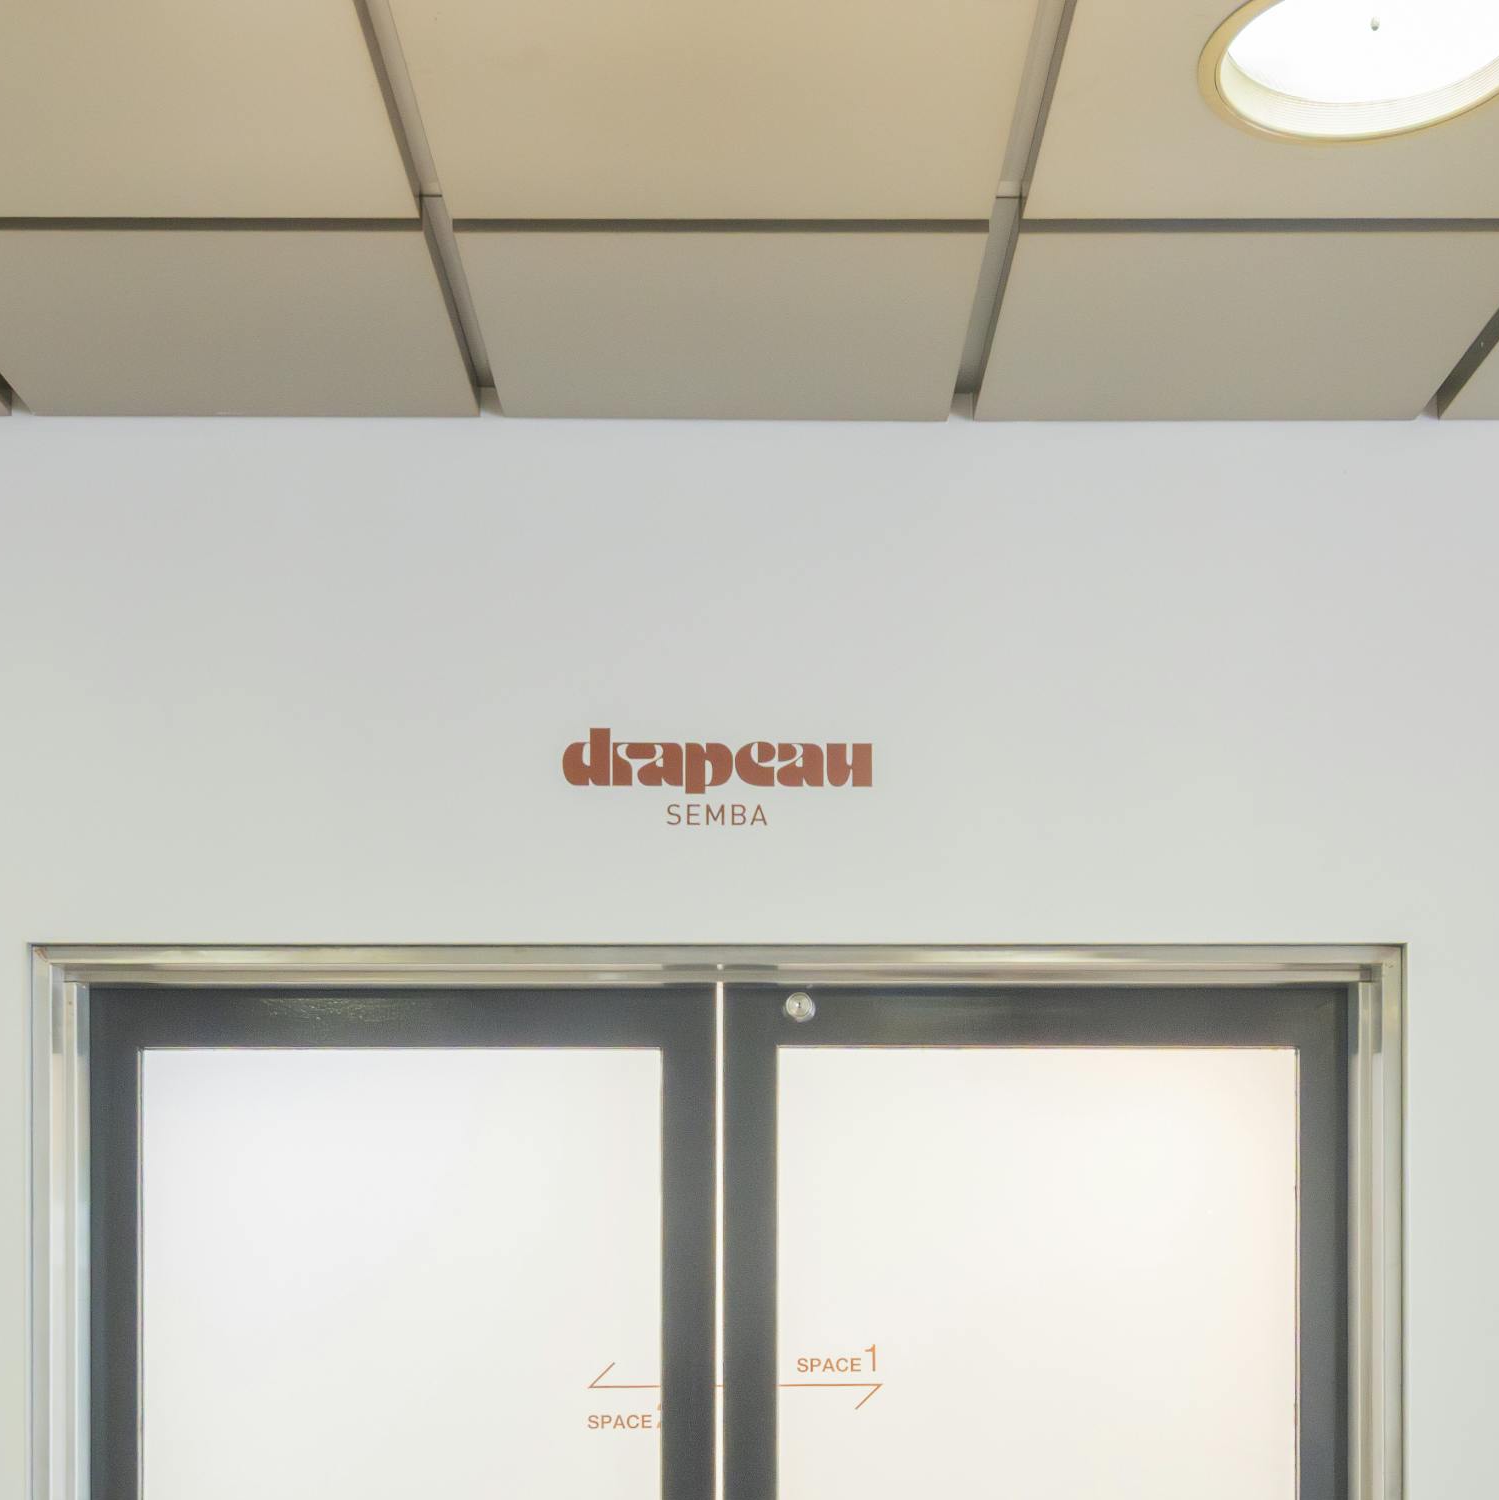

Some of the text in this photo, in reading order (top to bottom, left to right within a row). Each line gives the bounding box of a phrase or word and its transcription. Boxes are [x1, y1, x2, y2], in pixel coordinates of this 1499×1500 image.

[562, 727, 873, 794] drapeau
[666, 803, 768, 826] SEMBA
[797, 1343, 877, 1373] SPACE 1
[587, 1414, 653, 1430] SPACE
